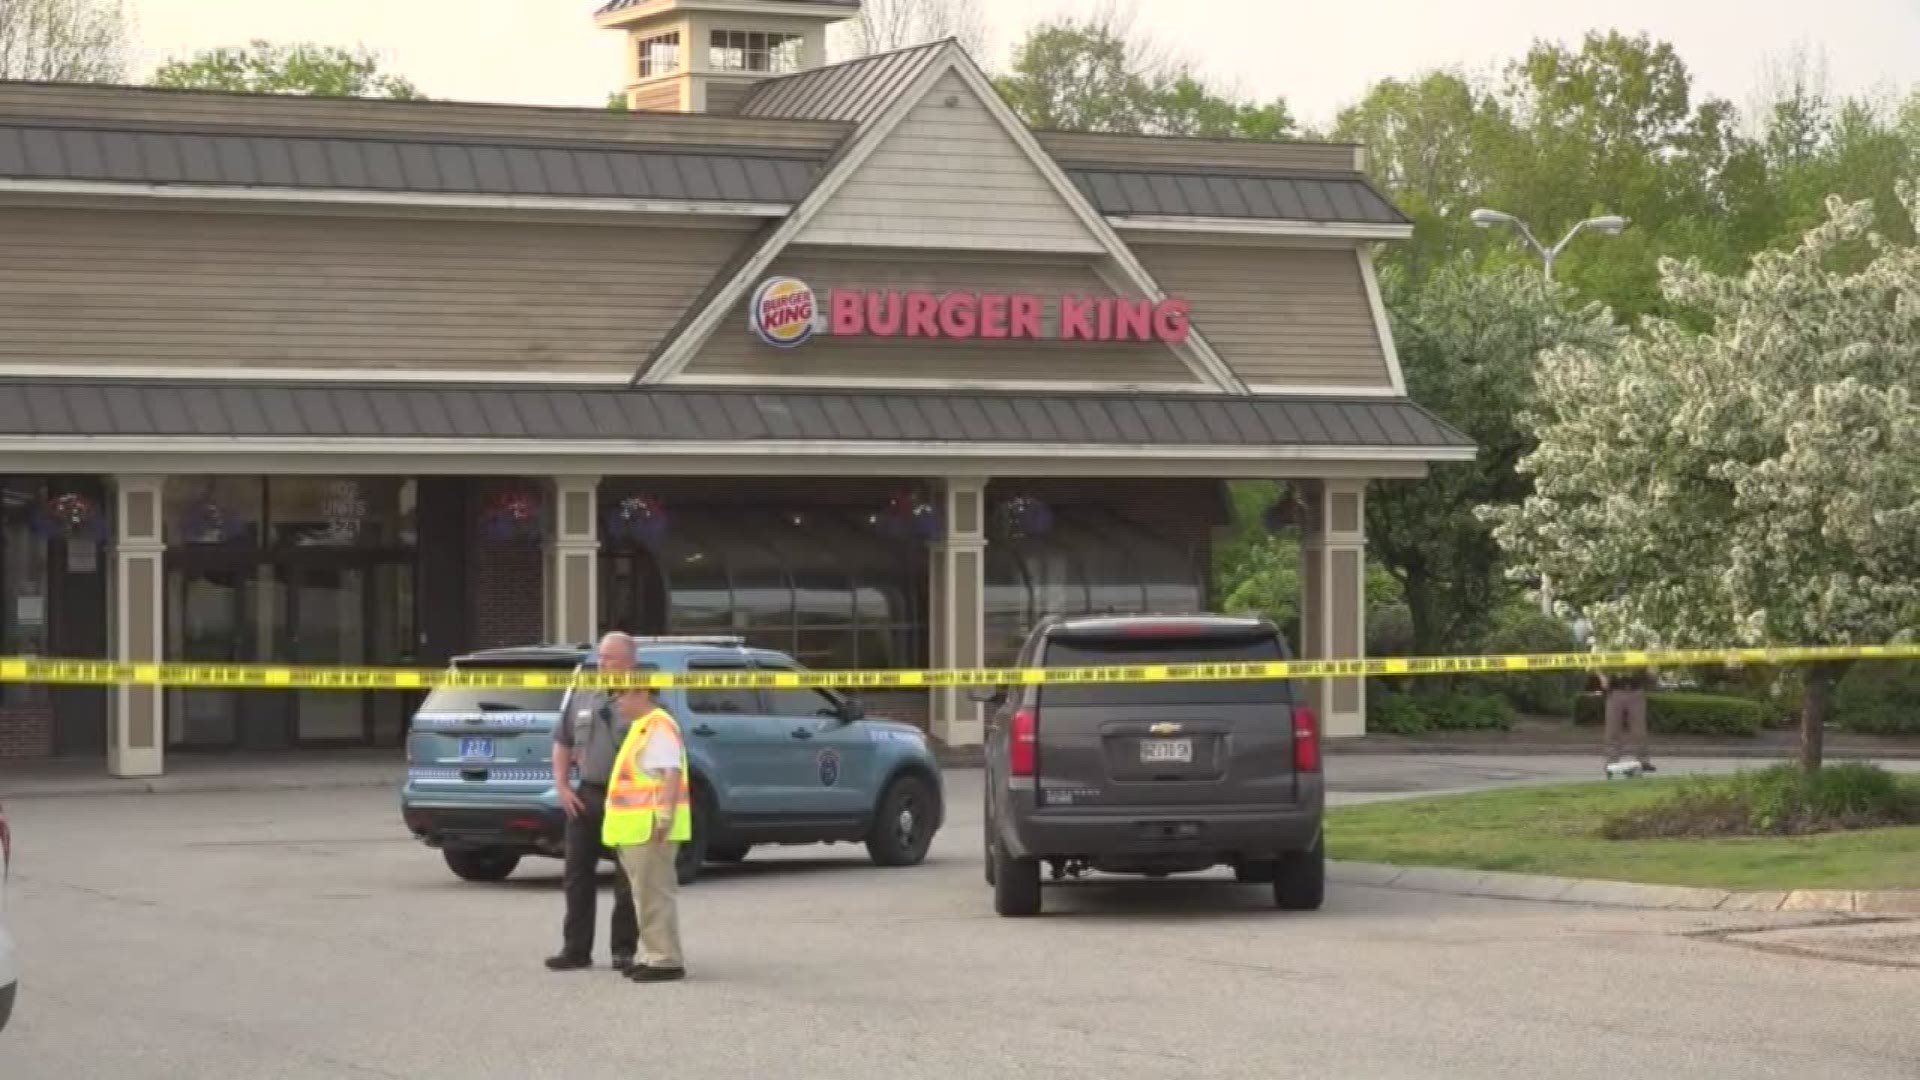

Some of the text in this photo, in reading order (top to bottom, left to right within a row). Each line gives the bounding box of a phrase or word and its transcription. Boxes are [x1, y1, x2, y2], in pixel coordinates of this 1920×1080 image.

[764, 304, 812, 330] KING
[830, 287, 1190, 342] BURGER KING
